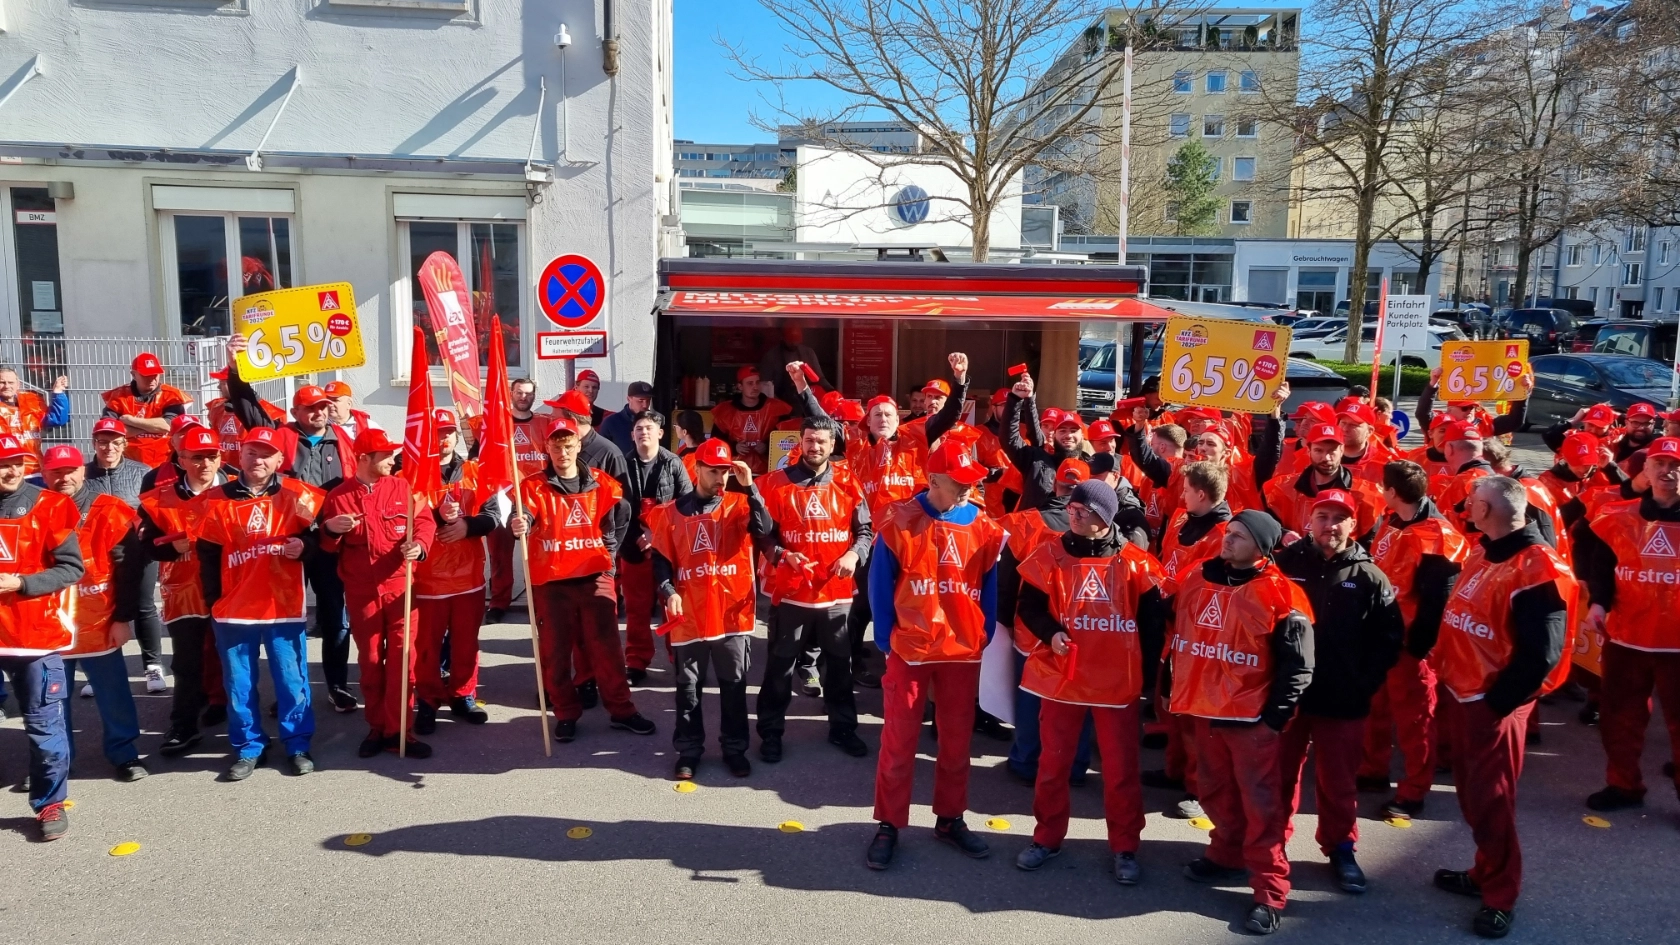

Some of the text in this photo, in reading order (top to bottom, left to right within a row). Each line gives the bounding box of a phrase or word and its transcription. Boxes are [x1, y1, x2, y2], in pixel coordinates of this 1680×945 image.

[28, 213, 46, 221] BMZ
[1293, 255, 1349, 263] Gebrauchtwagen
[1387, 300, 1426, 309] Einfahrt
[1386, 320, 1424, 329] Parkplatz
[247, 321, 348, 372] 6,5 %
[1262, 361, 1272, 369] 170
[1171, 352, 1267, 402] 6,5 %
[1448, 364, 1515, 397] 6,5 %
[910, 577, 935, 596] Wir
[1073, 614, 1139, 633] streike
